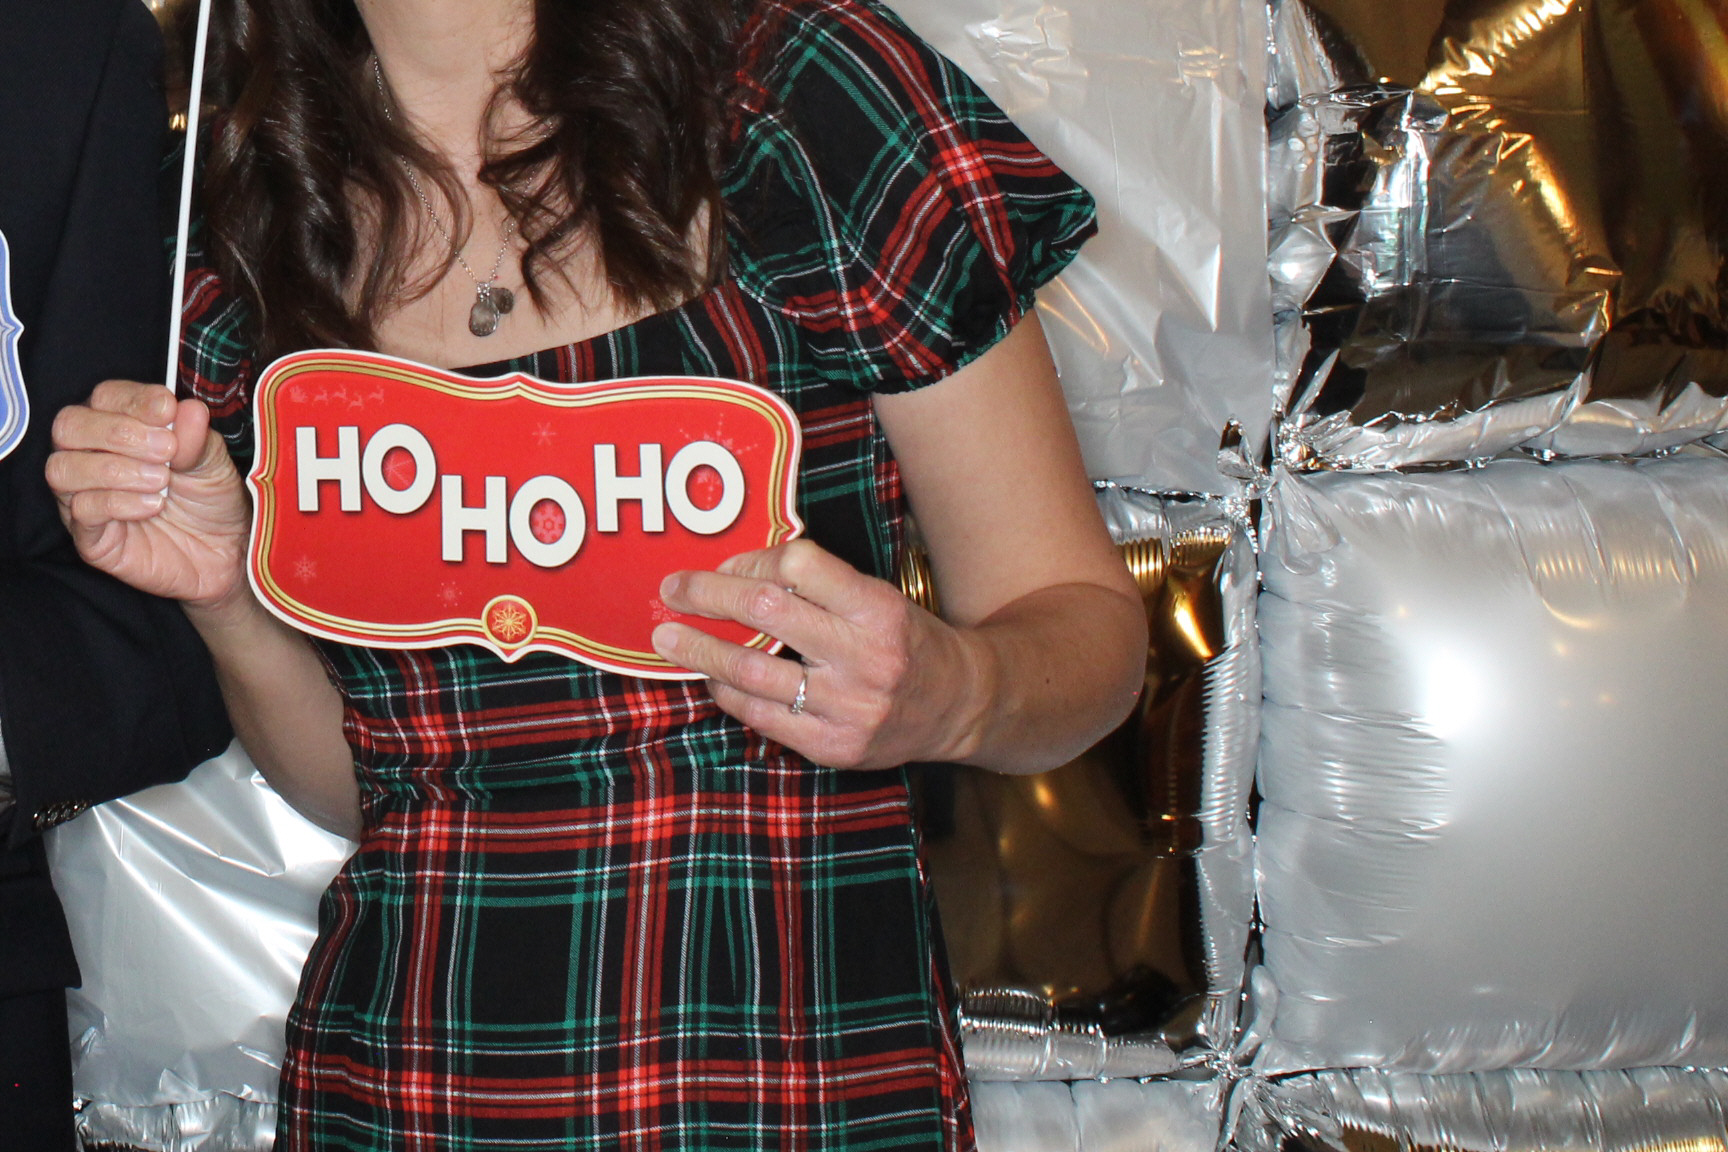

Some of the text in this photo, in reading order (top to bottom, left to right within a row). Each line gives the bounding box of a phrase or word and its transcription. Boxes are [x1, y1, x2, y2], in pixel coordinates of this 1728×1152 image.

[295, 423, 746, 568] HO HO HO
